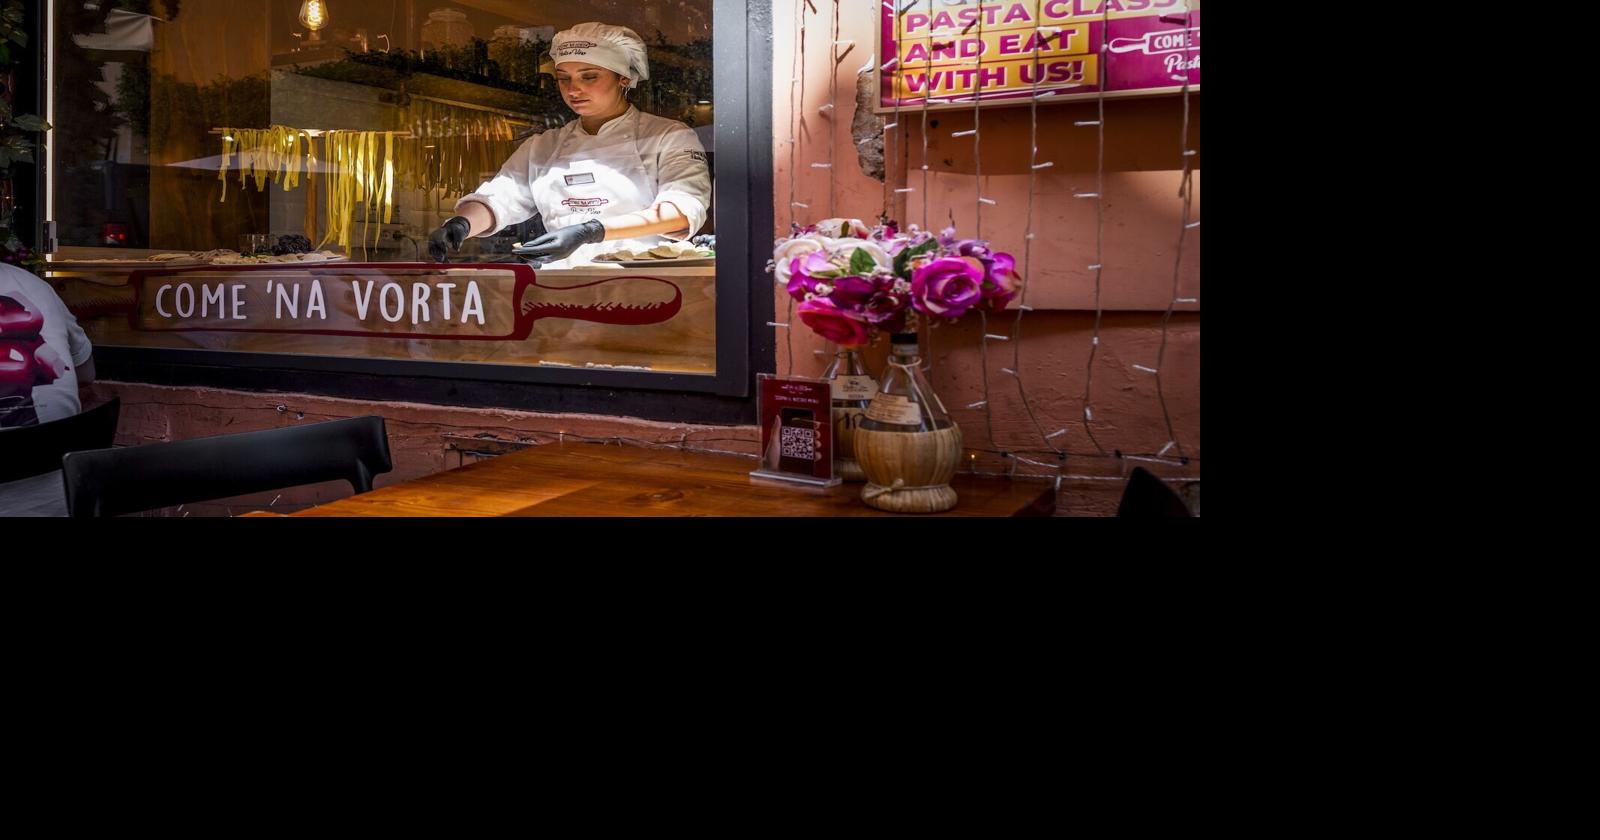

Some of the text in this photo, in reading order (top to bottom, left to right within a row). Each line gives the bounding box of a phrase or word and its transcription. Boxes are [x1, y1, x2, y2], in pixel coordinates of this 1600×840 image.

[906, 3, 1031, 33] PASTA
[905, 29, 1077, 63] AND EAT
[905, 60, 1085, 93] WITH US!
[156, 279, 486, 325] COME 'NA VORTA
